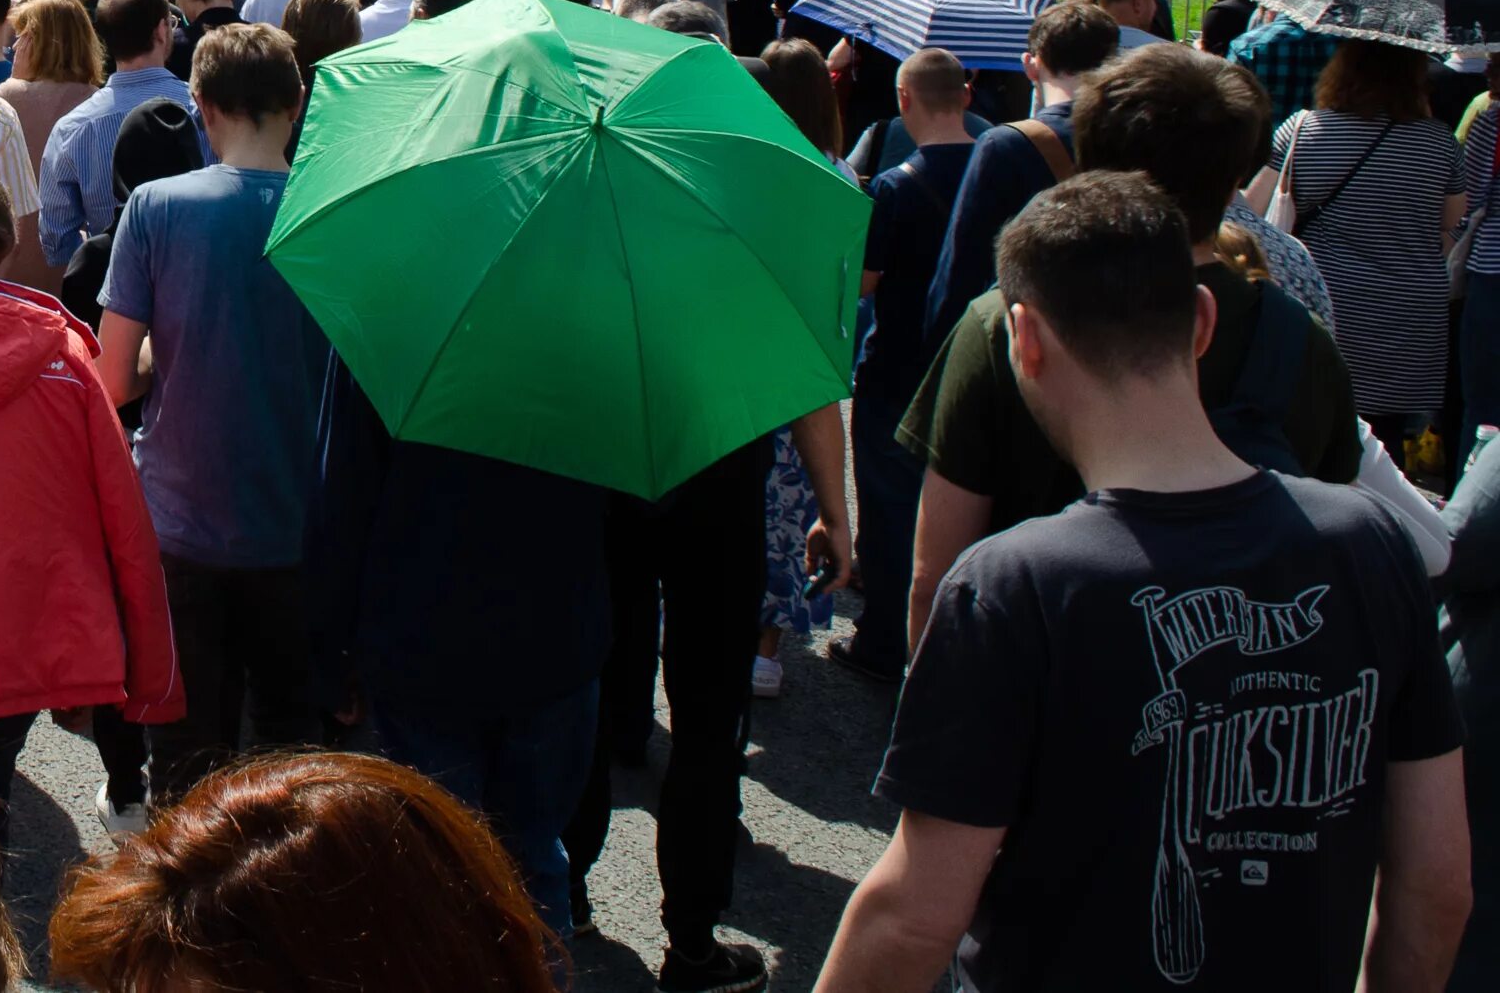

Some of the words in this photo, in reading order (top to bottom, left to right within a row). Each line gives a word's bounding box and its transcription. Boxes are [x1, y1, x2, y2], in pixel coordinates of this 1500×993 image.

[1230, 671, 1322, 698] AUTHENTIC
[1186, 668, 1379, 844] QUIKSILVER
[1206, 830, 1318, 852] COLLECTION
